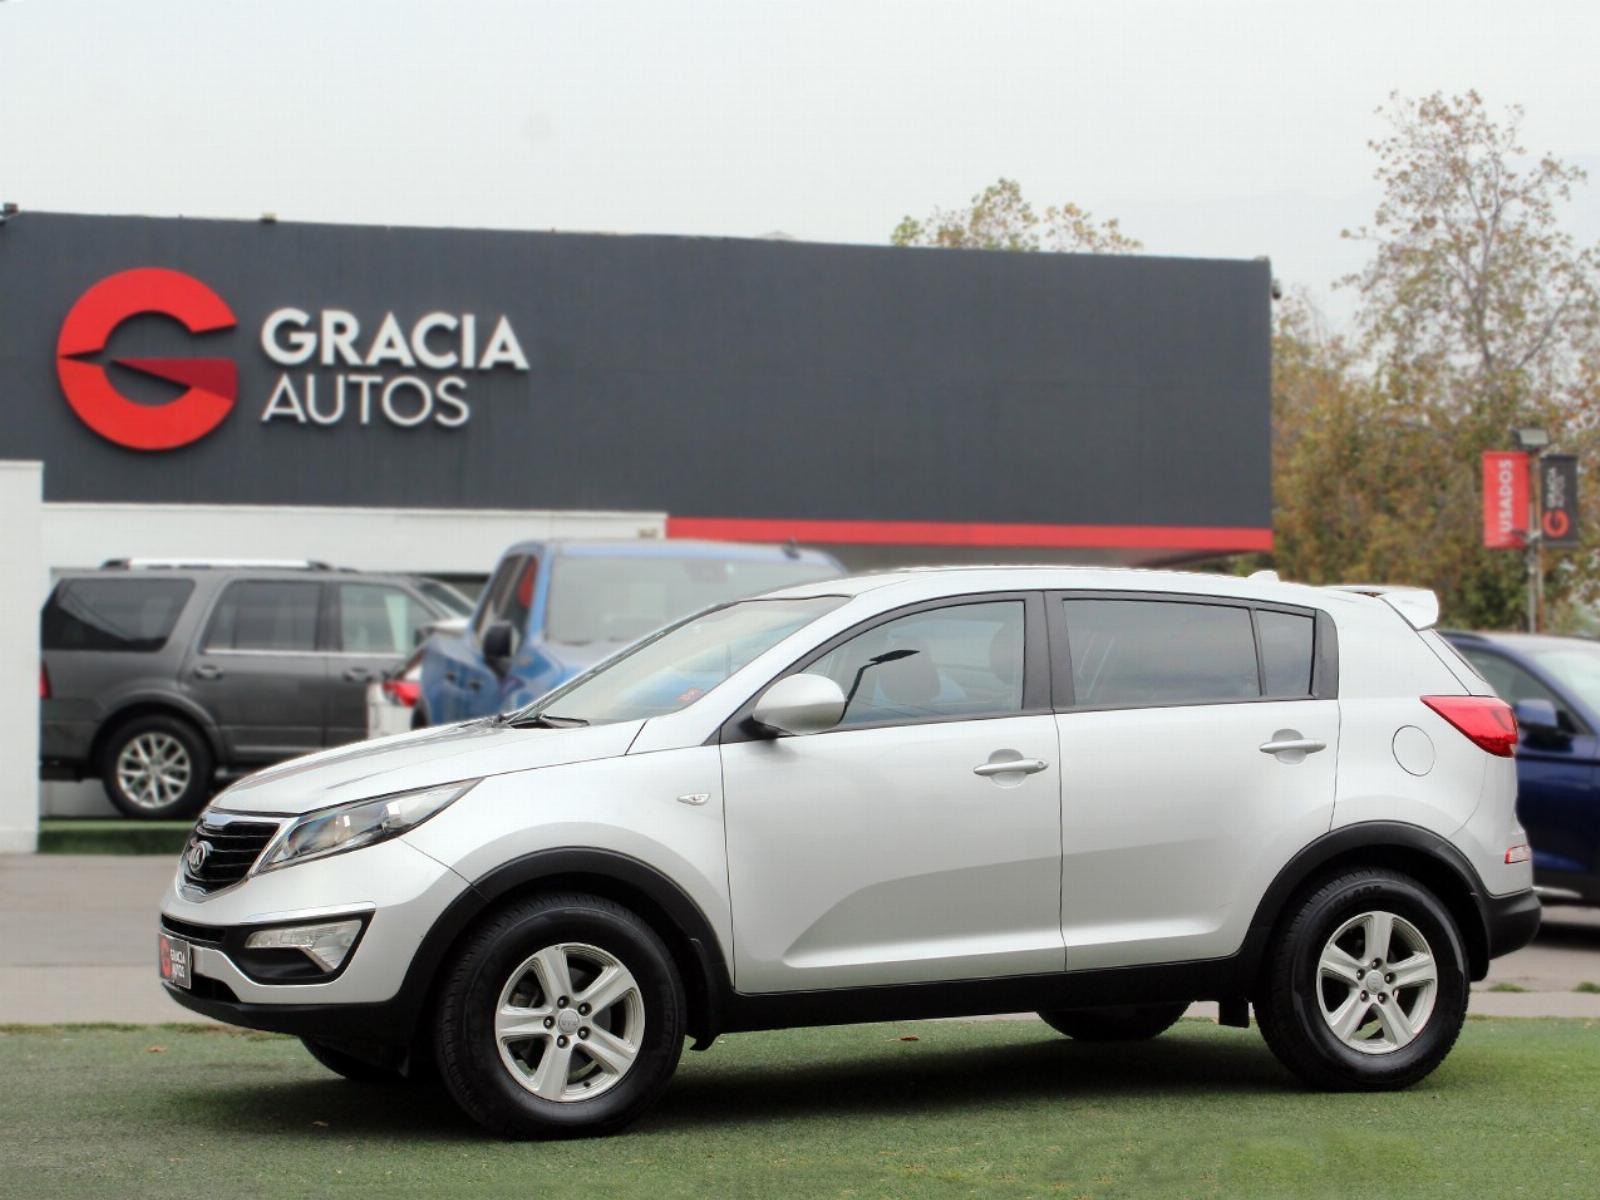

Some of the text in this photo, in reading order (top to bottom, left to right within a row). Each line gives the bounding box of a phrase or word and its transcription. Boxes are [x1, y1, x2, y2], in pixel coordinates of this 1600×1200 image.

[261, 308, 529, 370] GRACIA
[262, 374, 470, 427] AUTOS
[1498, 459, 1514, 533] USADOS
